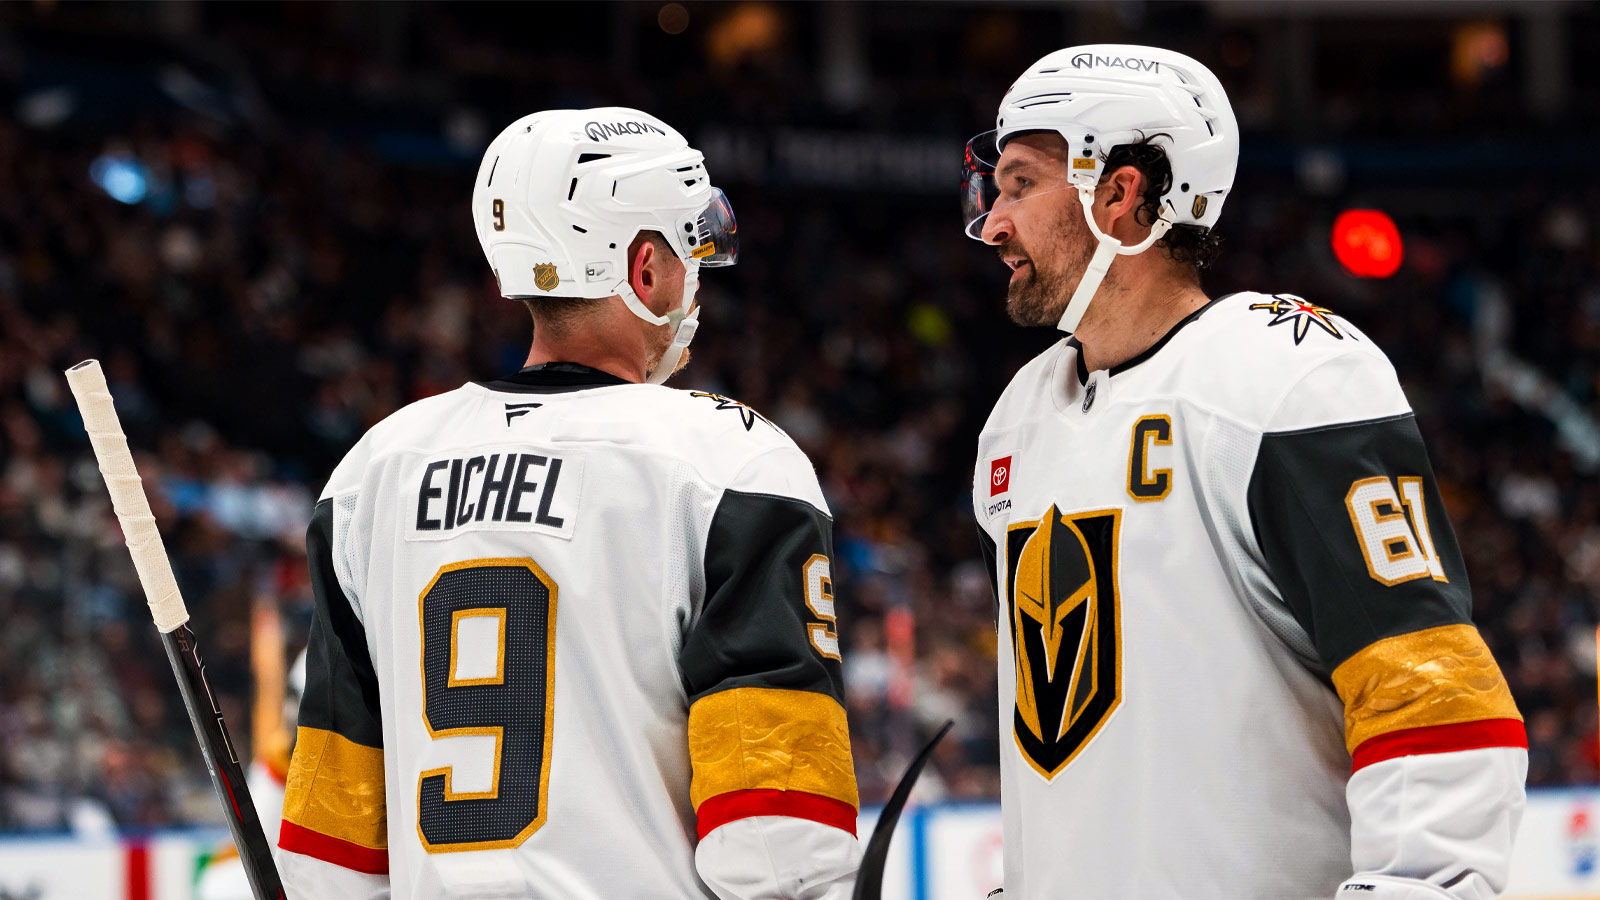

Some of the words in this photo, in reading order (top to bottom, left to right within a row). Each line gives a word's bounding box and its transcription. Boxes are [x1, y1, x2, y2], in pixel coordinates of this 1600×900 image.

[493, 198, 505, 232] 9
[416, 453, 564, 531] EICHEL
[1126, 413, 1173, 502] C
[988, 499, 1012, 517] TOYOTA
[1344, 475, 1449, 587] 61
[416, 557, 559, 854] 9
